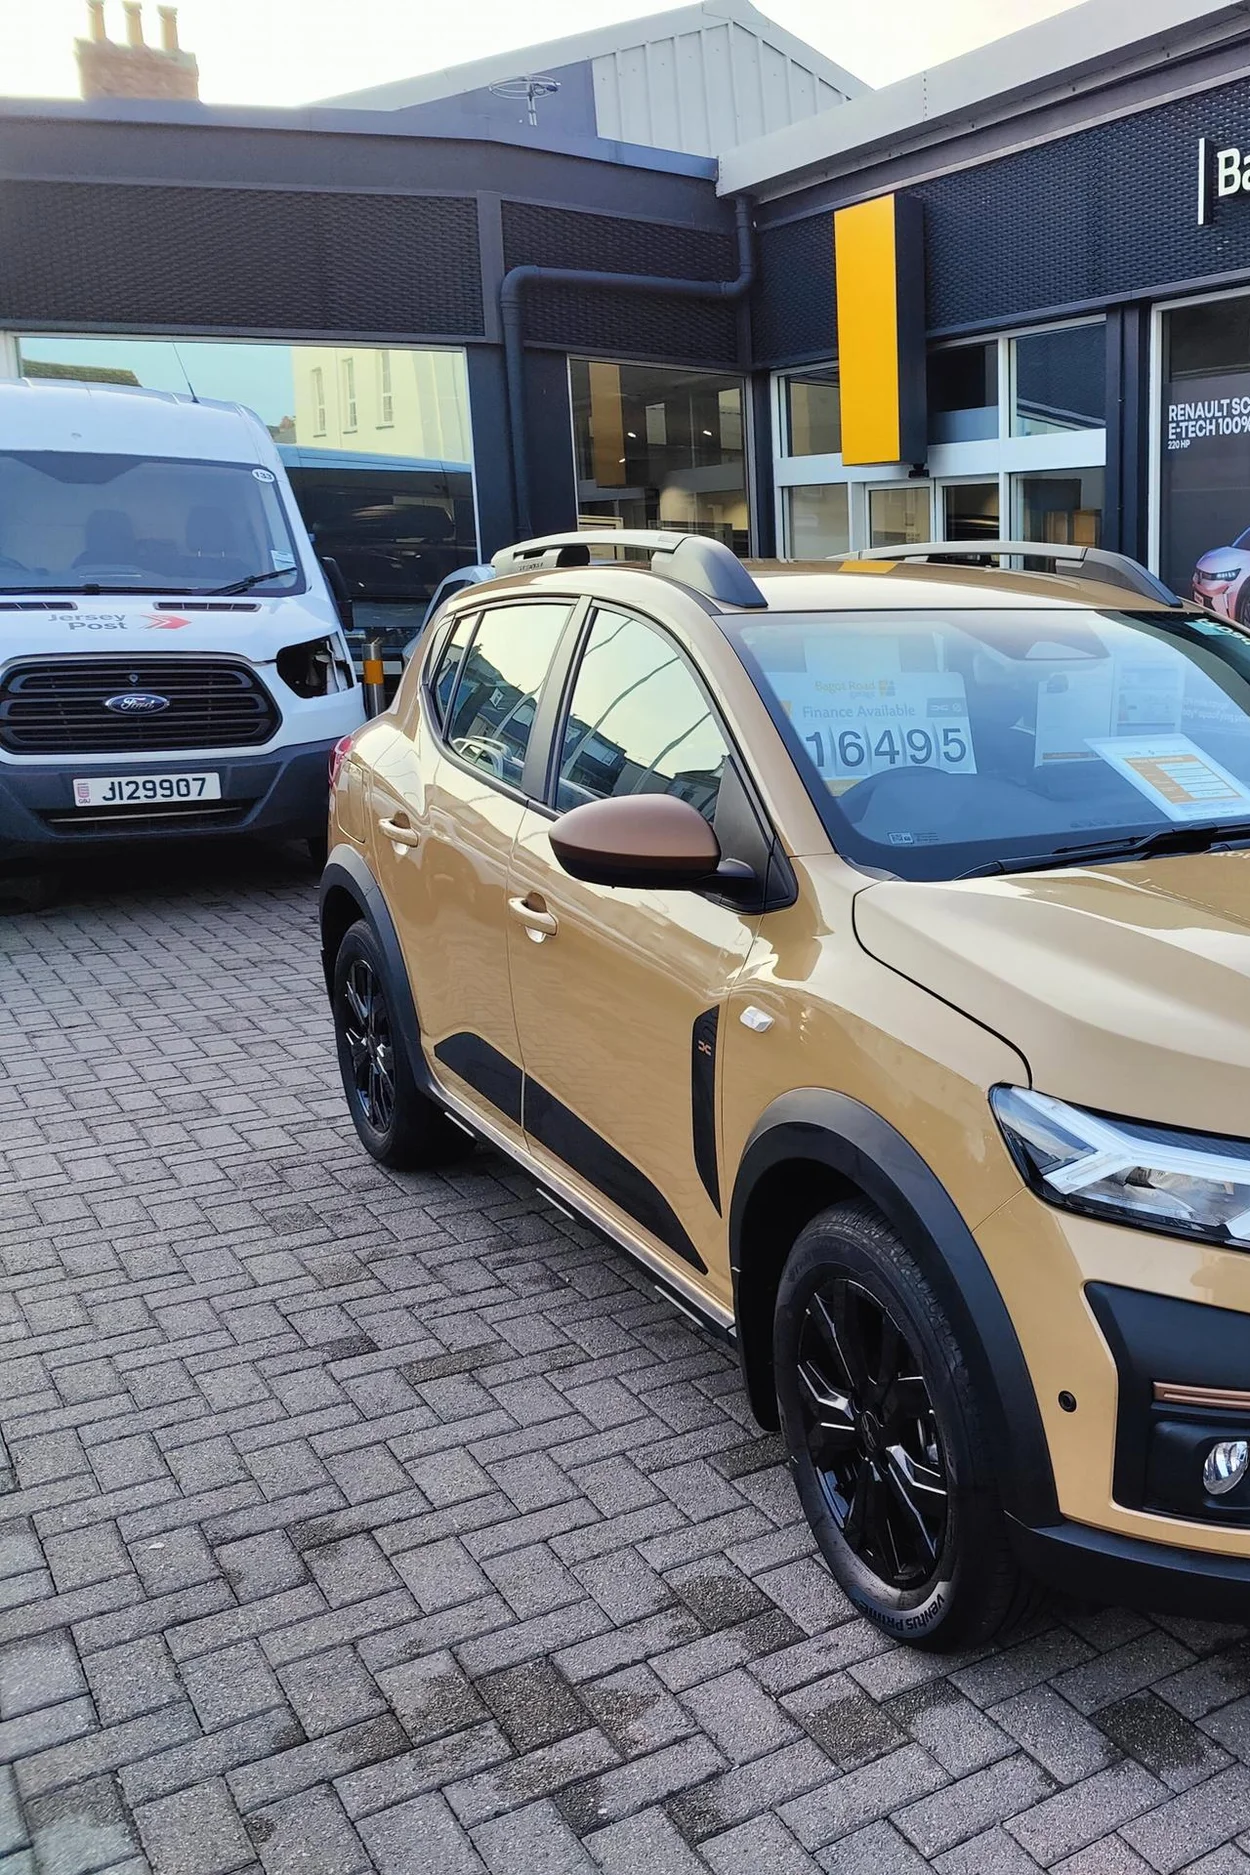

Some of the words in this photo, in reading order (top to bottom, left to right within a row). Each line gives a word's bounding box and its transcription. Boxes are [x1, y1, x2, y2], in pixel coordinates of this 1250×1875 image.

[1168, 399, 1231, 421] RENAULT
[1168, 418, 1217, 440] E-TECH
[1168, 440, 1180, 450] 220
[1180, 439, 1191, 449] HP
[48, 614, 127, 623] Jersey
[68, 621, 129, 631] Post
[849, 679, 876, 690] Road
[121, 697, 155, 711] Ford
[802, 706, 853, 719] Finance
[857, 702, 916, 718] Available
[805, 728, 967, 768] 16495
[102, 777, 207, 802] J129907
